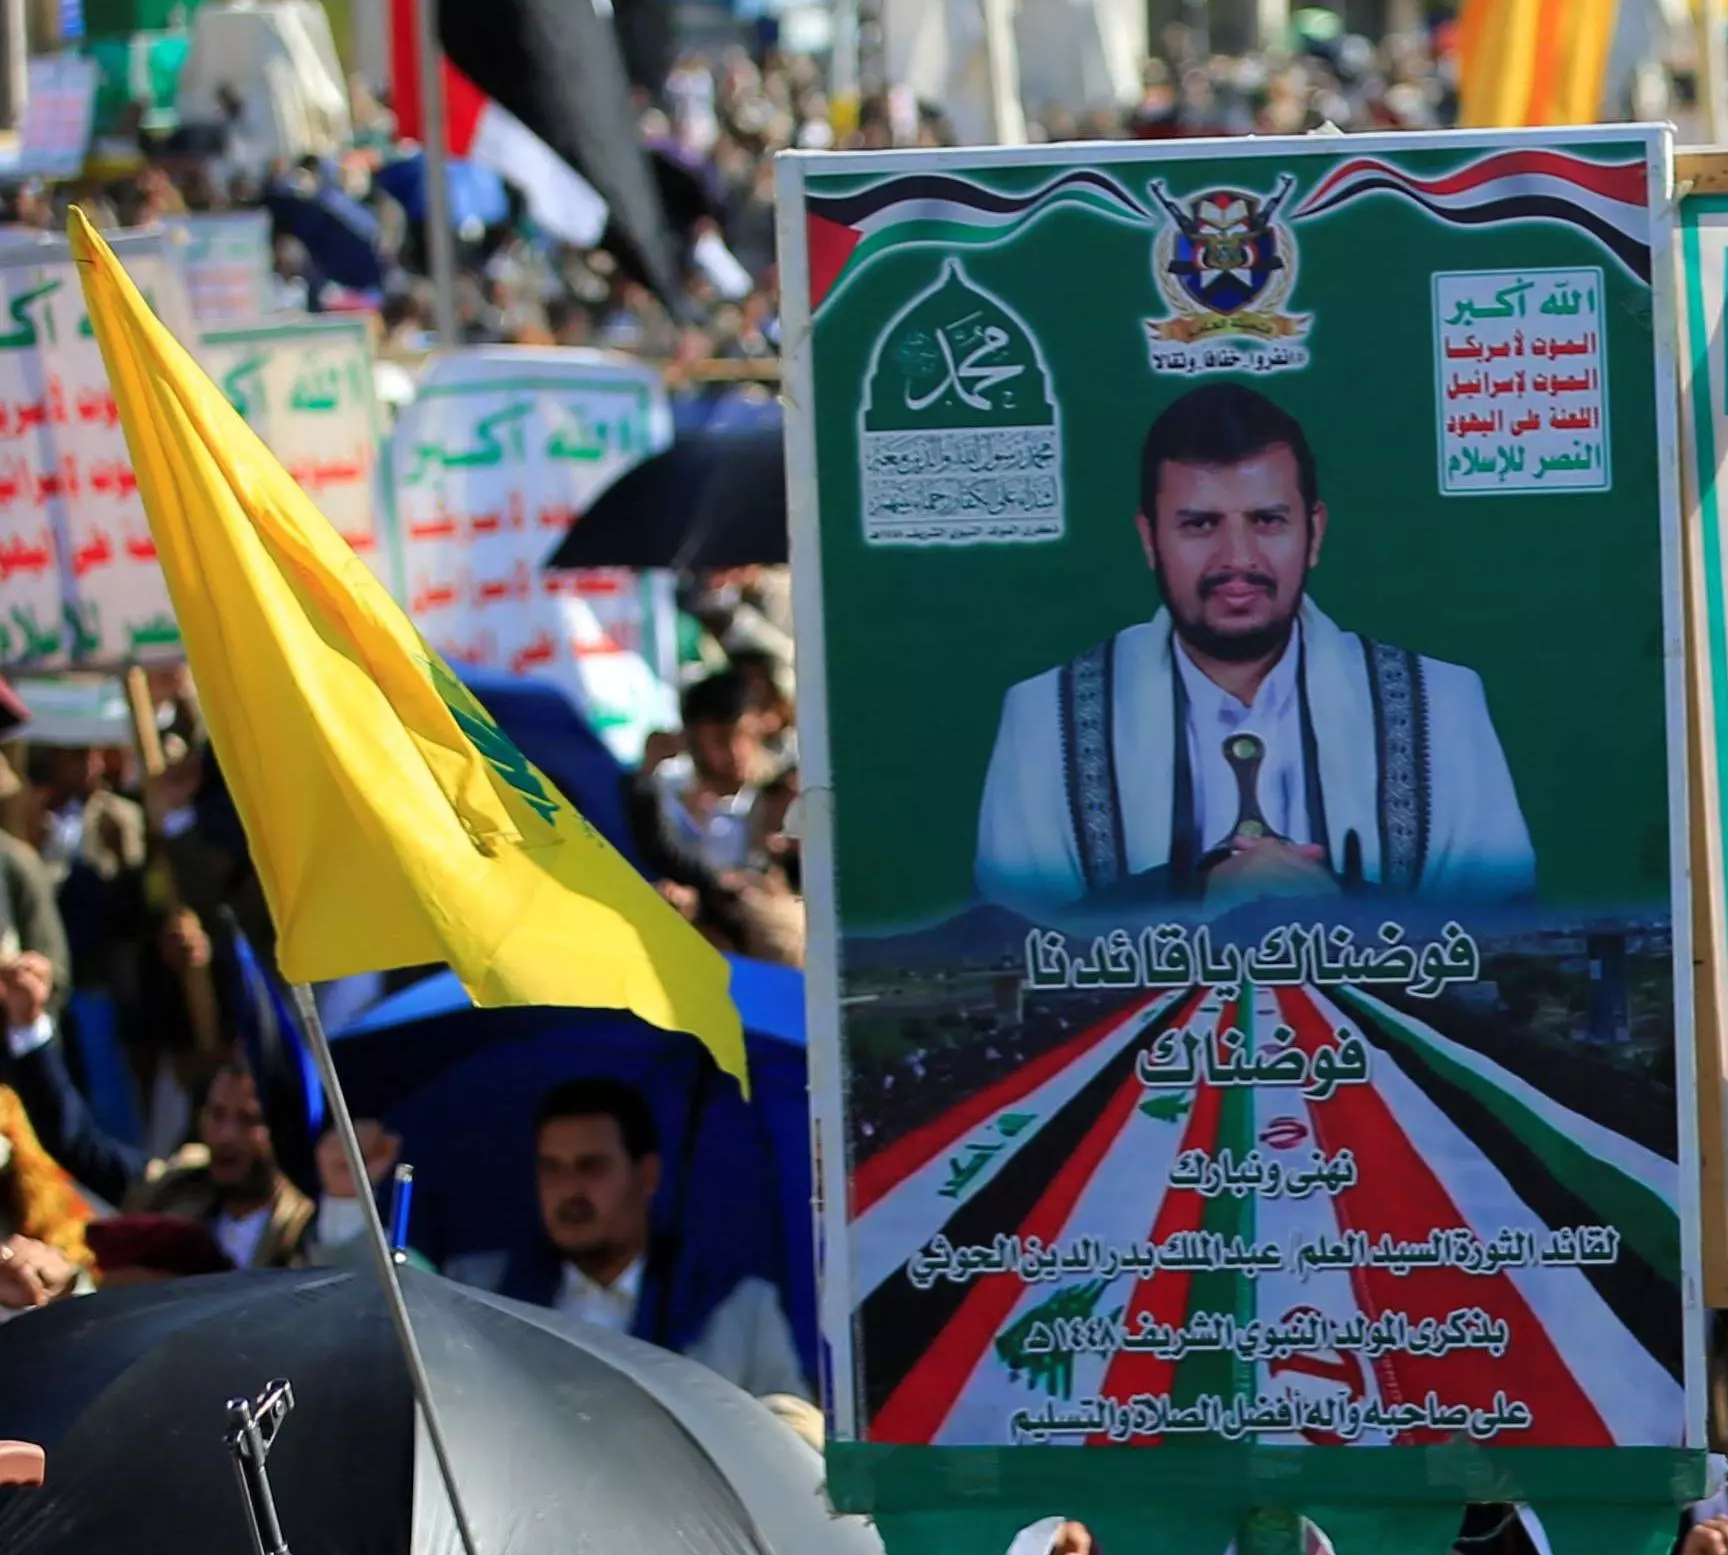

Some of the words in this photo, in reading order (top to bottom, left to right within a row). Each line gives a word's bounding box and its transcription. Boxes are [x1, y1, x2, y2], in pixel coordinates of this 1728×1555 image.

[1444, 276, 1535, 326] أكبر
[1540, 280, 1595, 316] الله
[1445, 329, 1525, 363] لأمريكا
[1531, 332, 1597, 361] الموت
[1532, 368, 1598, 396] الموت
[1447, 409, 1503, 438] اليهود
[1510, 409, 1541, 437] على
[1549, 407, 1600, 430] اللعنة
[1448, 444, 1526, 483] للإسلام
[1532, 440, 1601, 480] النصر
[1245, 922, 1480, 999] فوضناك
[1136, 1022, 1370, 1101] فوضناك
[1468, 1391, 1534, 1439] على
